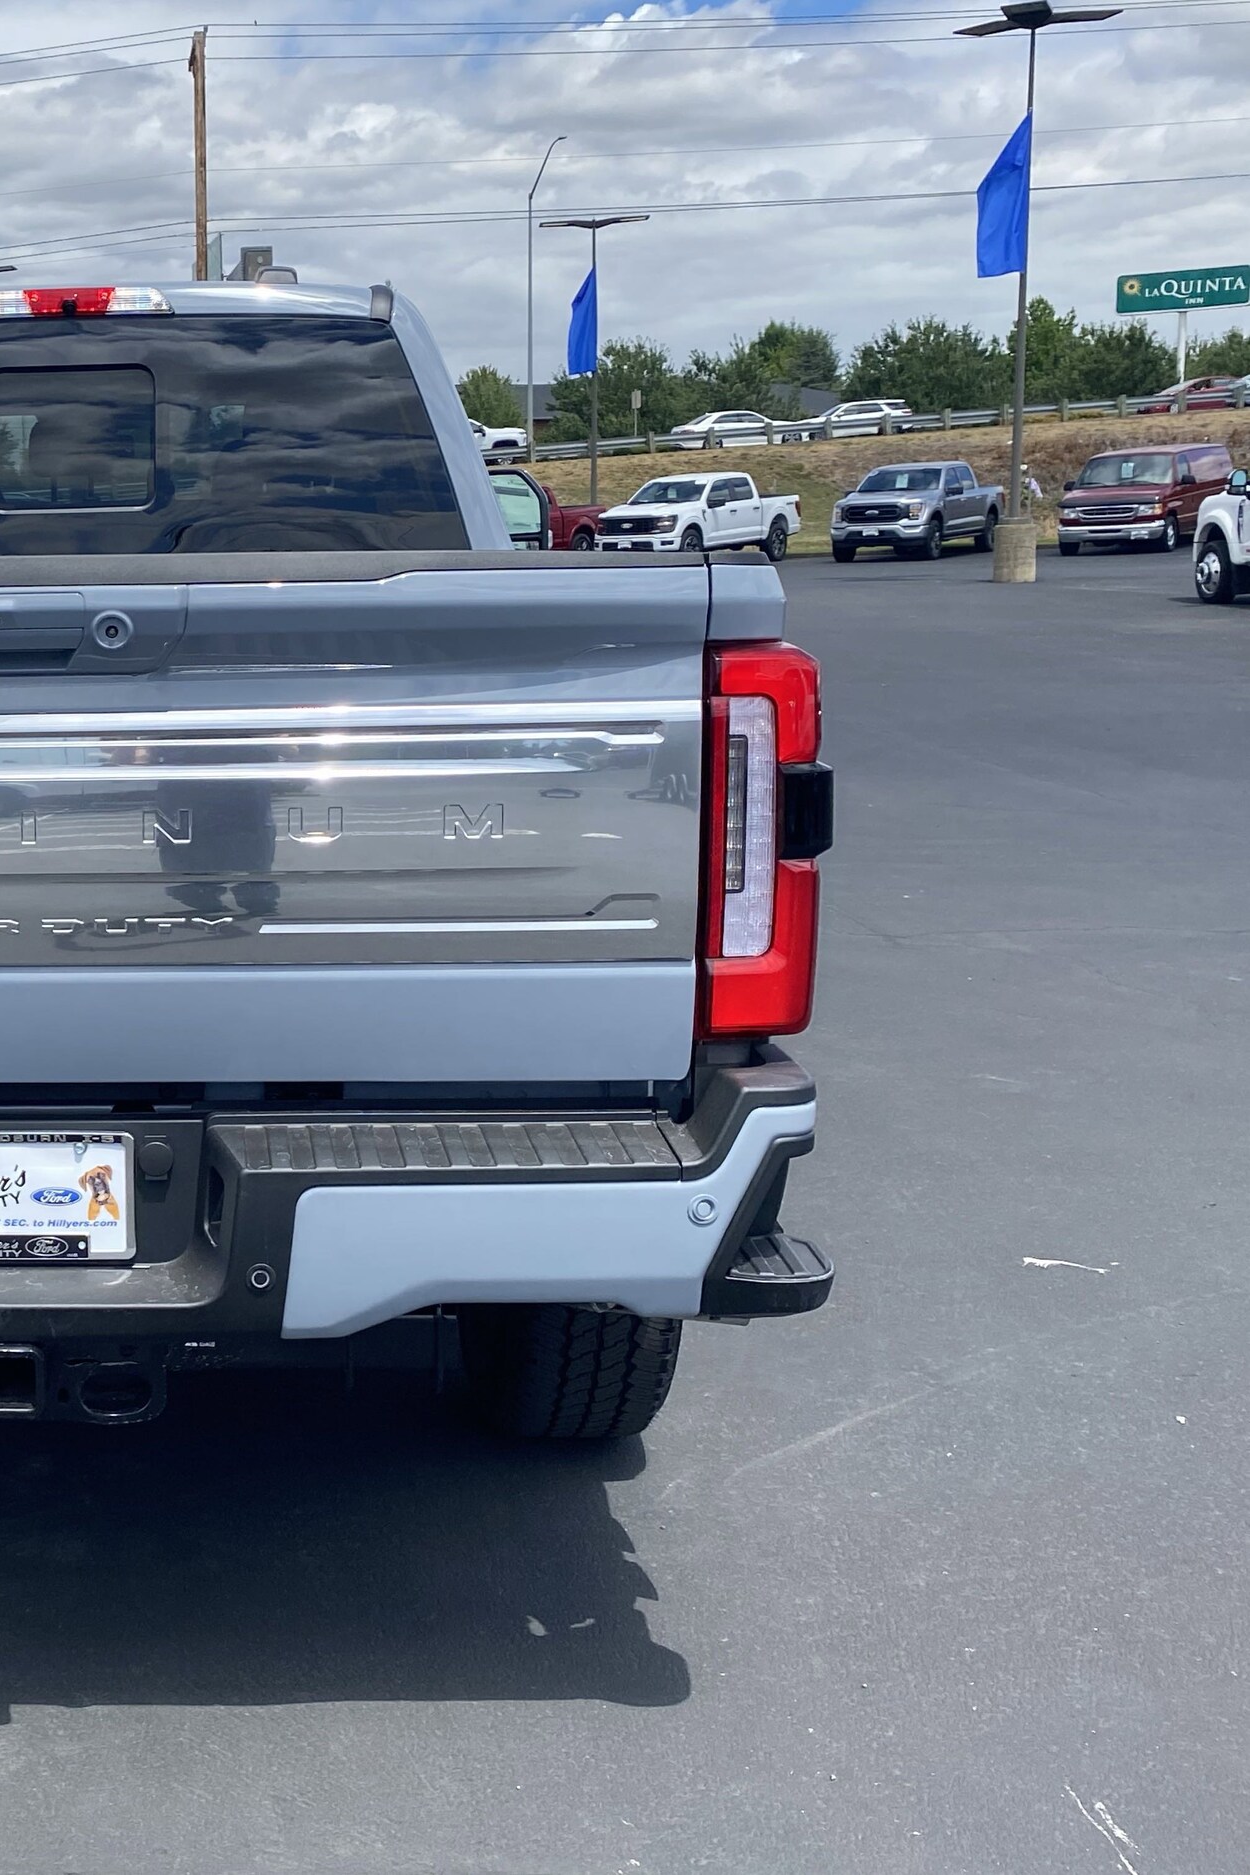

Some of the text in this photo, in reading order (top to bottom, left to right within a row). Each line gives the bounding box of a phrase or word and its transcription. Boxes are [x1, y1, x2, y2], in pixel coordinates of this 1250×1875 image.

[1145, 276, 1247, 298] LA QUINTA
[41, 917, 234, 935] DUTY
[40, 1189, 73, 1204] Ford
[3, 1219, 30, 1227] SEC.
[33, 1219, 44, 1227] to
[47, 1218, 118, 1229] Hillyers.com
[34, 1238, 60, 1254] Ford
